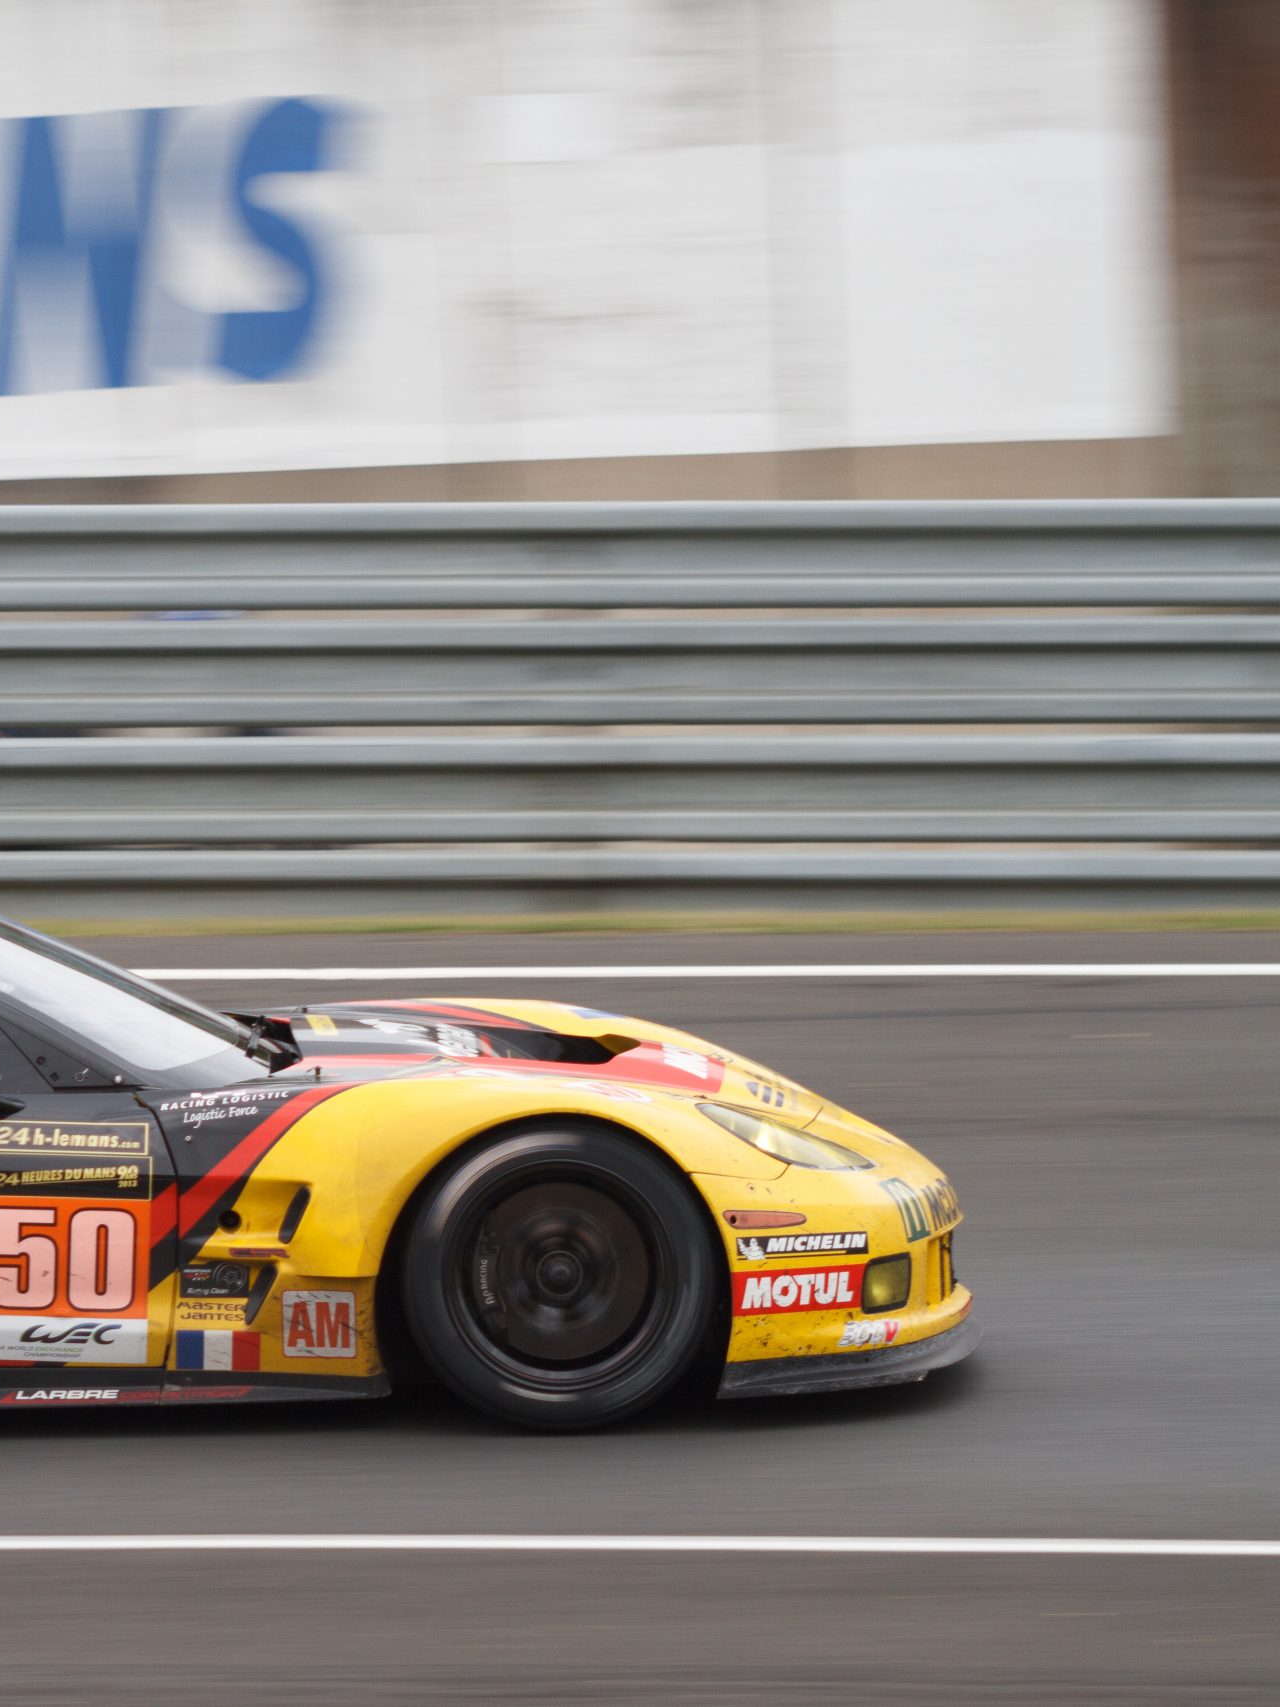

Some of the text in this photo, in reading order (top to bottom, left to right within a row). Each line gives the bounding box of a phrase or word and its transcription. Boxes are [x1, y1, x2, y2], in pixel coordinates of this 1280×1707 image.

[160, 1090, 290, 1111] RACING LOGISTIC
[183, 1105, 258, 1128] Logistic Force
[21, 1169, 63, 1183] HEURES
[65, 1167, 82, 1181] DU
[83, 1166, 116, 1179] MANS
[767, 1232, 867, 1252] MICHELIN
[741, 1271, 854, 1310] MOTUL
[19, 1322, 122, 1345] WEC
[287, 1302, 351, 1348] AM
[838, 1319, 901, 1347] 300V
[15, 1389, 119, 1400] LARBRE
